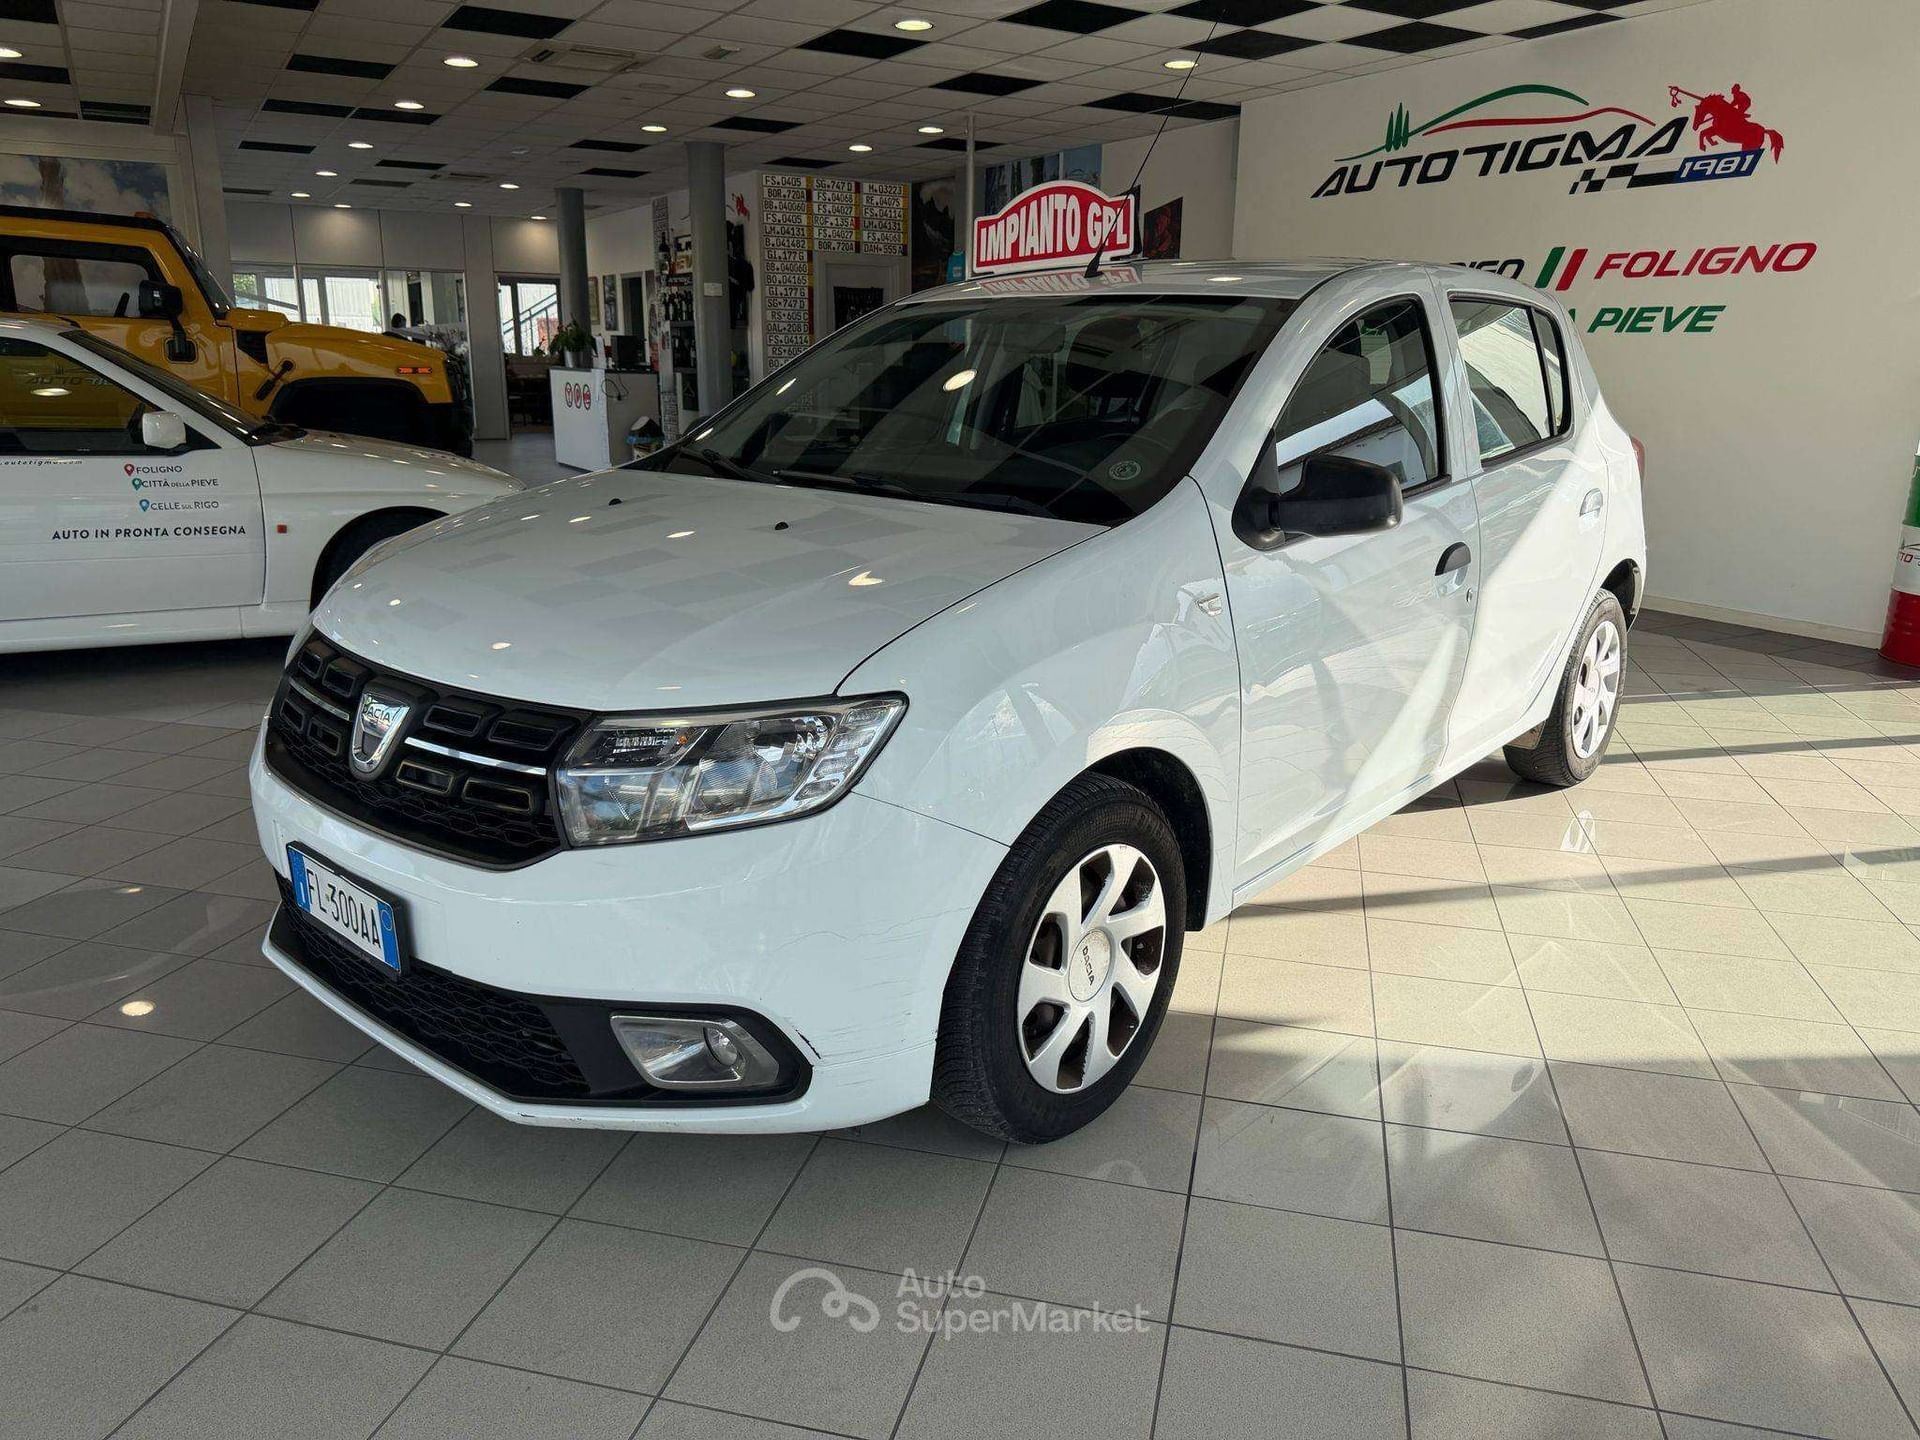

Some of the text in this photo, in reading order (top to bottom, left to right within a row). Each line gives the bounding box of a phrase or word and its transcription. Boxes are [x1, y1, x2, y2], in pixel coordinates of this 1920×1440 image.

[1678, 154, 1757, 179] 1981
[979, 194, 1128, 263] IMPIANTO GPL
[1593, 242, 1818, 281] FOLIGNO
[1587, 305, 1726, 334] PIEVE
[136, 465, 183, 474] FOLIGNO
[142, 478, 170, 488] CITTÀ
[191, 479, 219, 487] PIEVE
[150, 502, 181, 511] CELLE
[194, 501, 219, 510] RIGO
[52, 525, 247, 541] AUTO IN PRONTA CONSEGNA
[1082, 945, 1095, 986] DACIA
